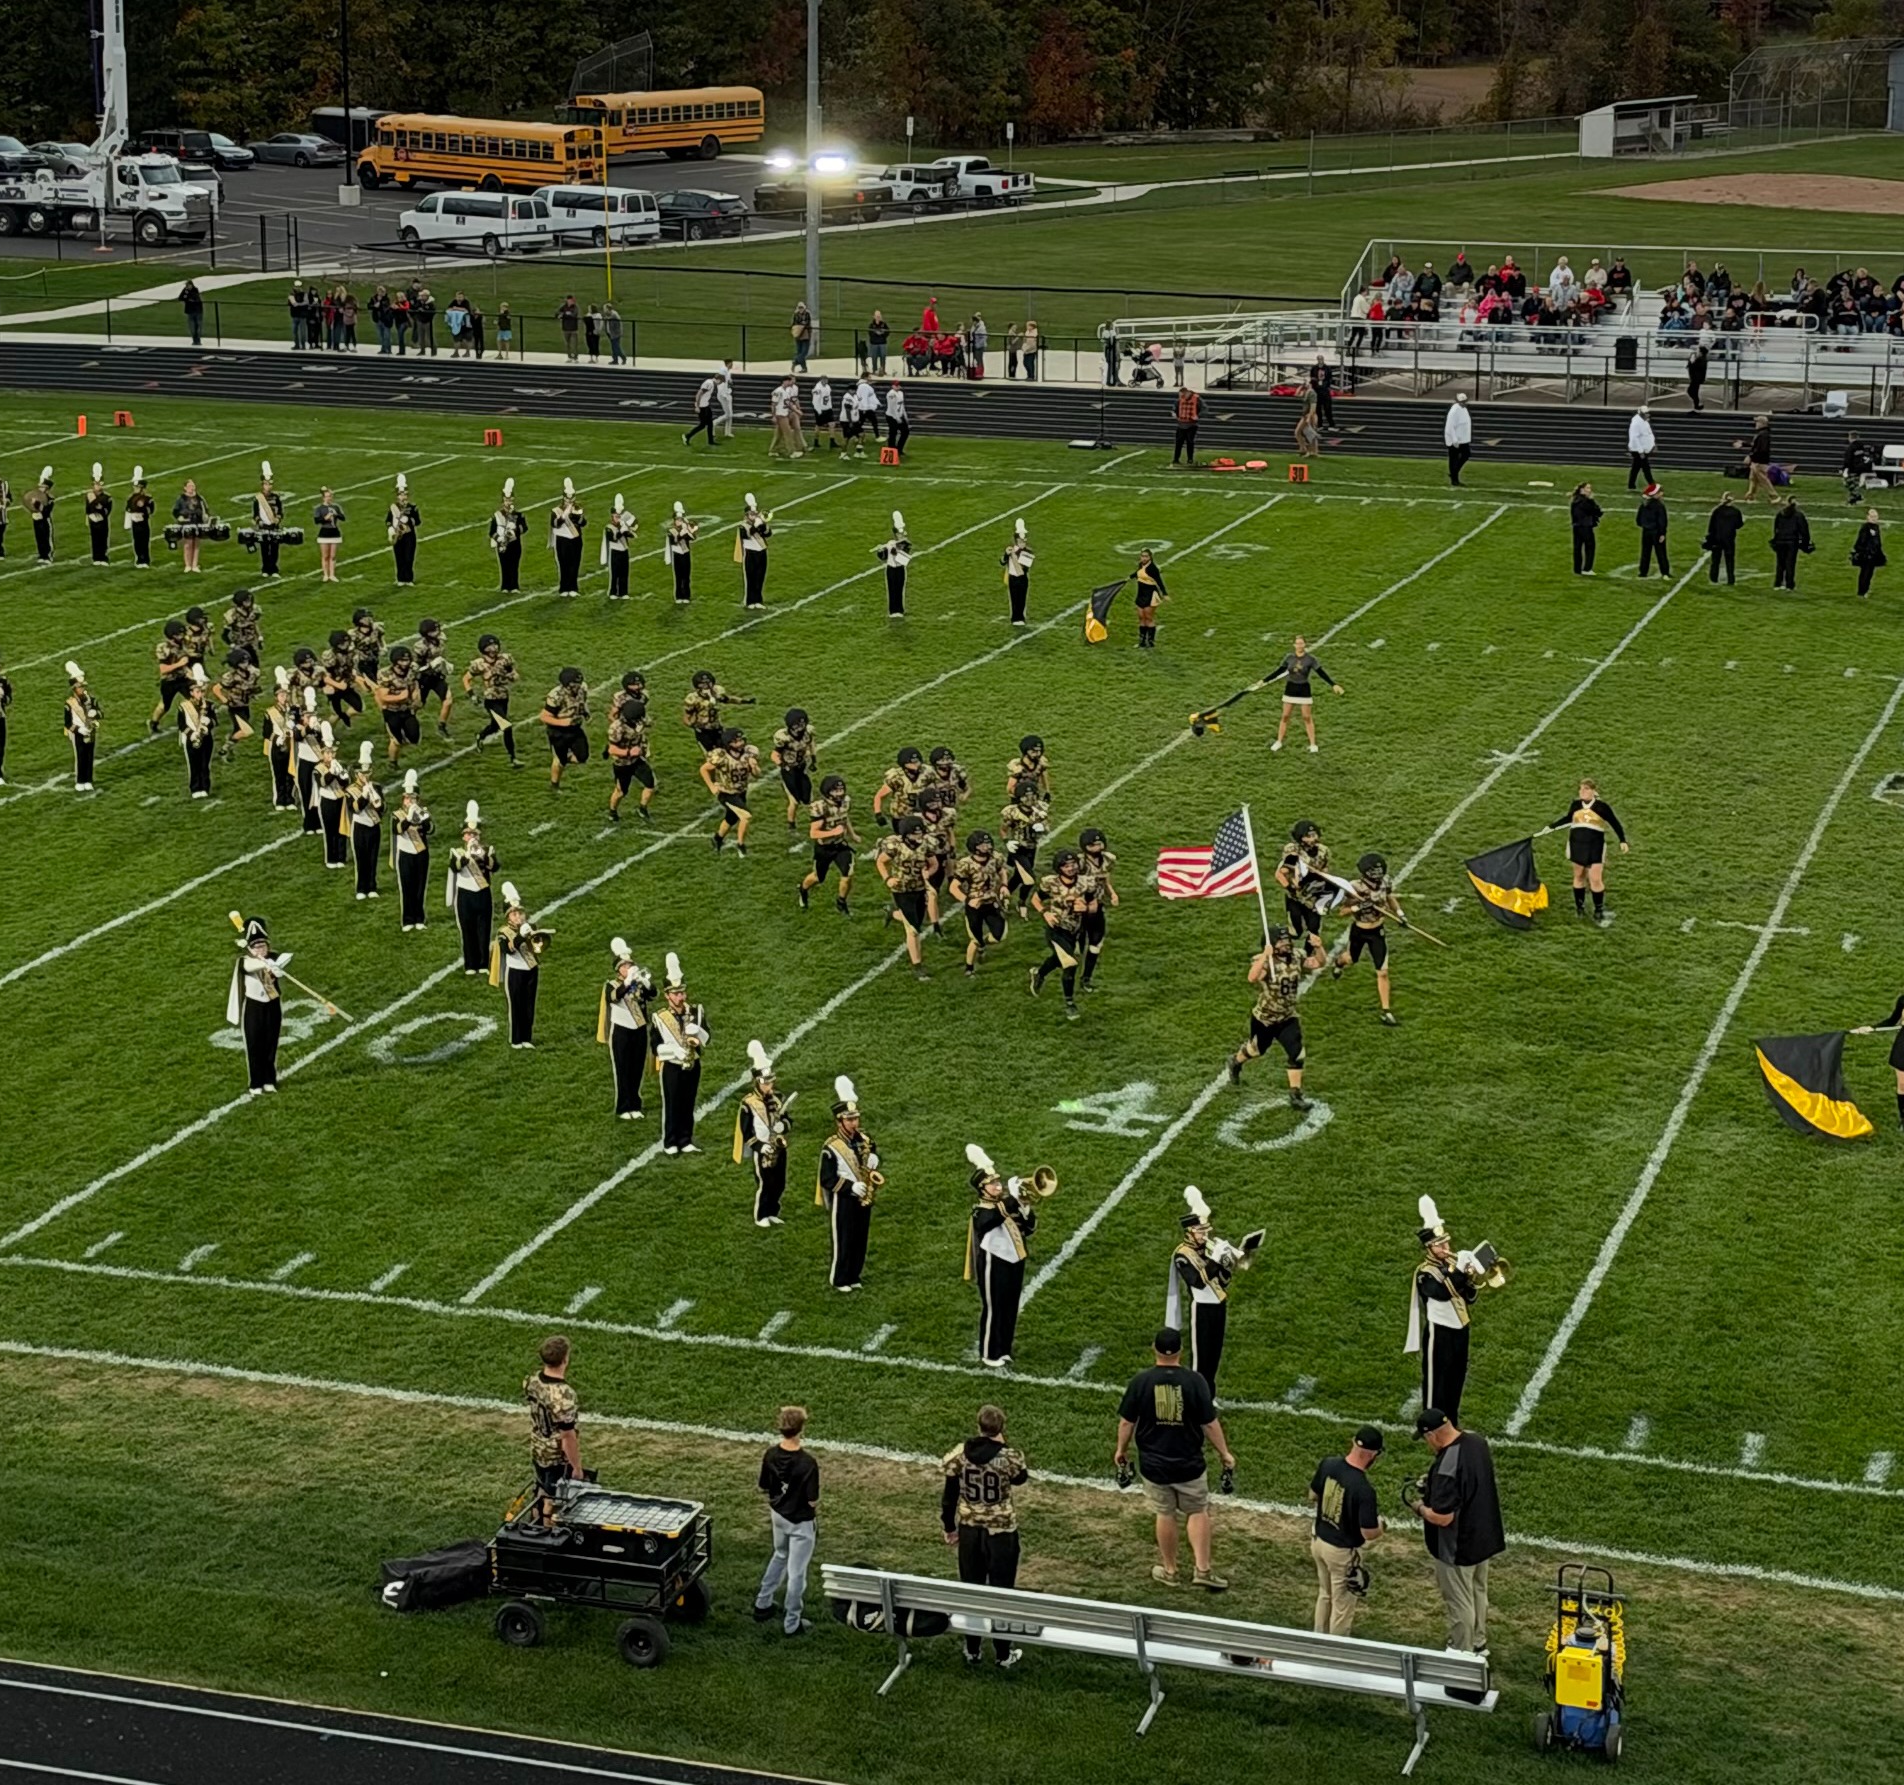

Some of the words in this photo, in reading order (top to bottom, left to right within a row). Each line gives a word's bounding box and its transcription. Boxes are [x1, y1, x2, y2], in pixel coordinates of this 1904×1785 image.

[882, 450, 894, 463] 20
[730, 765, 749, 784] 62
[1049, 1080, 1335, 1152] 40
[964, 1468, 1002, 1504] 58
